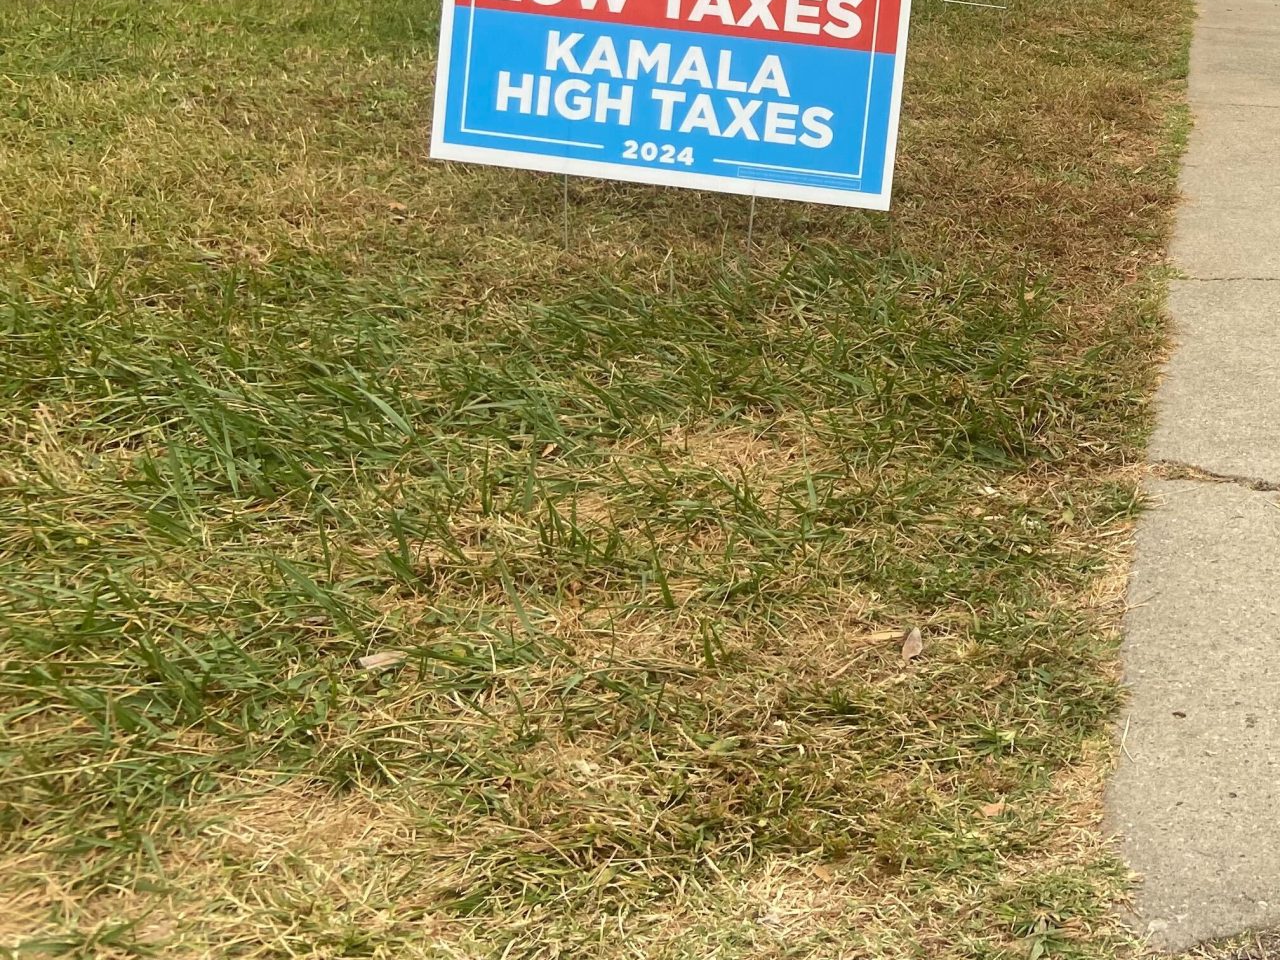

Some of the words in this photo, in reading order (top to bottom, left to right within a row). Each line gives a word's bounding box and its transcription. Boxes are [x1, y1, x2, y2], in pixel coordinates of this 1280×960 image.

[545, 30, 791, 98] KAMALA
[495, 71, 634, 126] HIGH
[651, 89, 834, 149] TAXES
[621, 140, 695, 166] 2024
